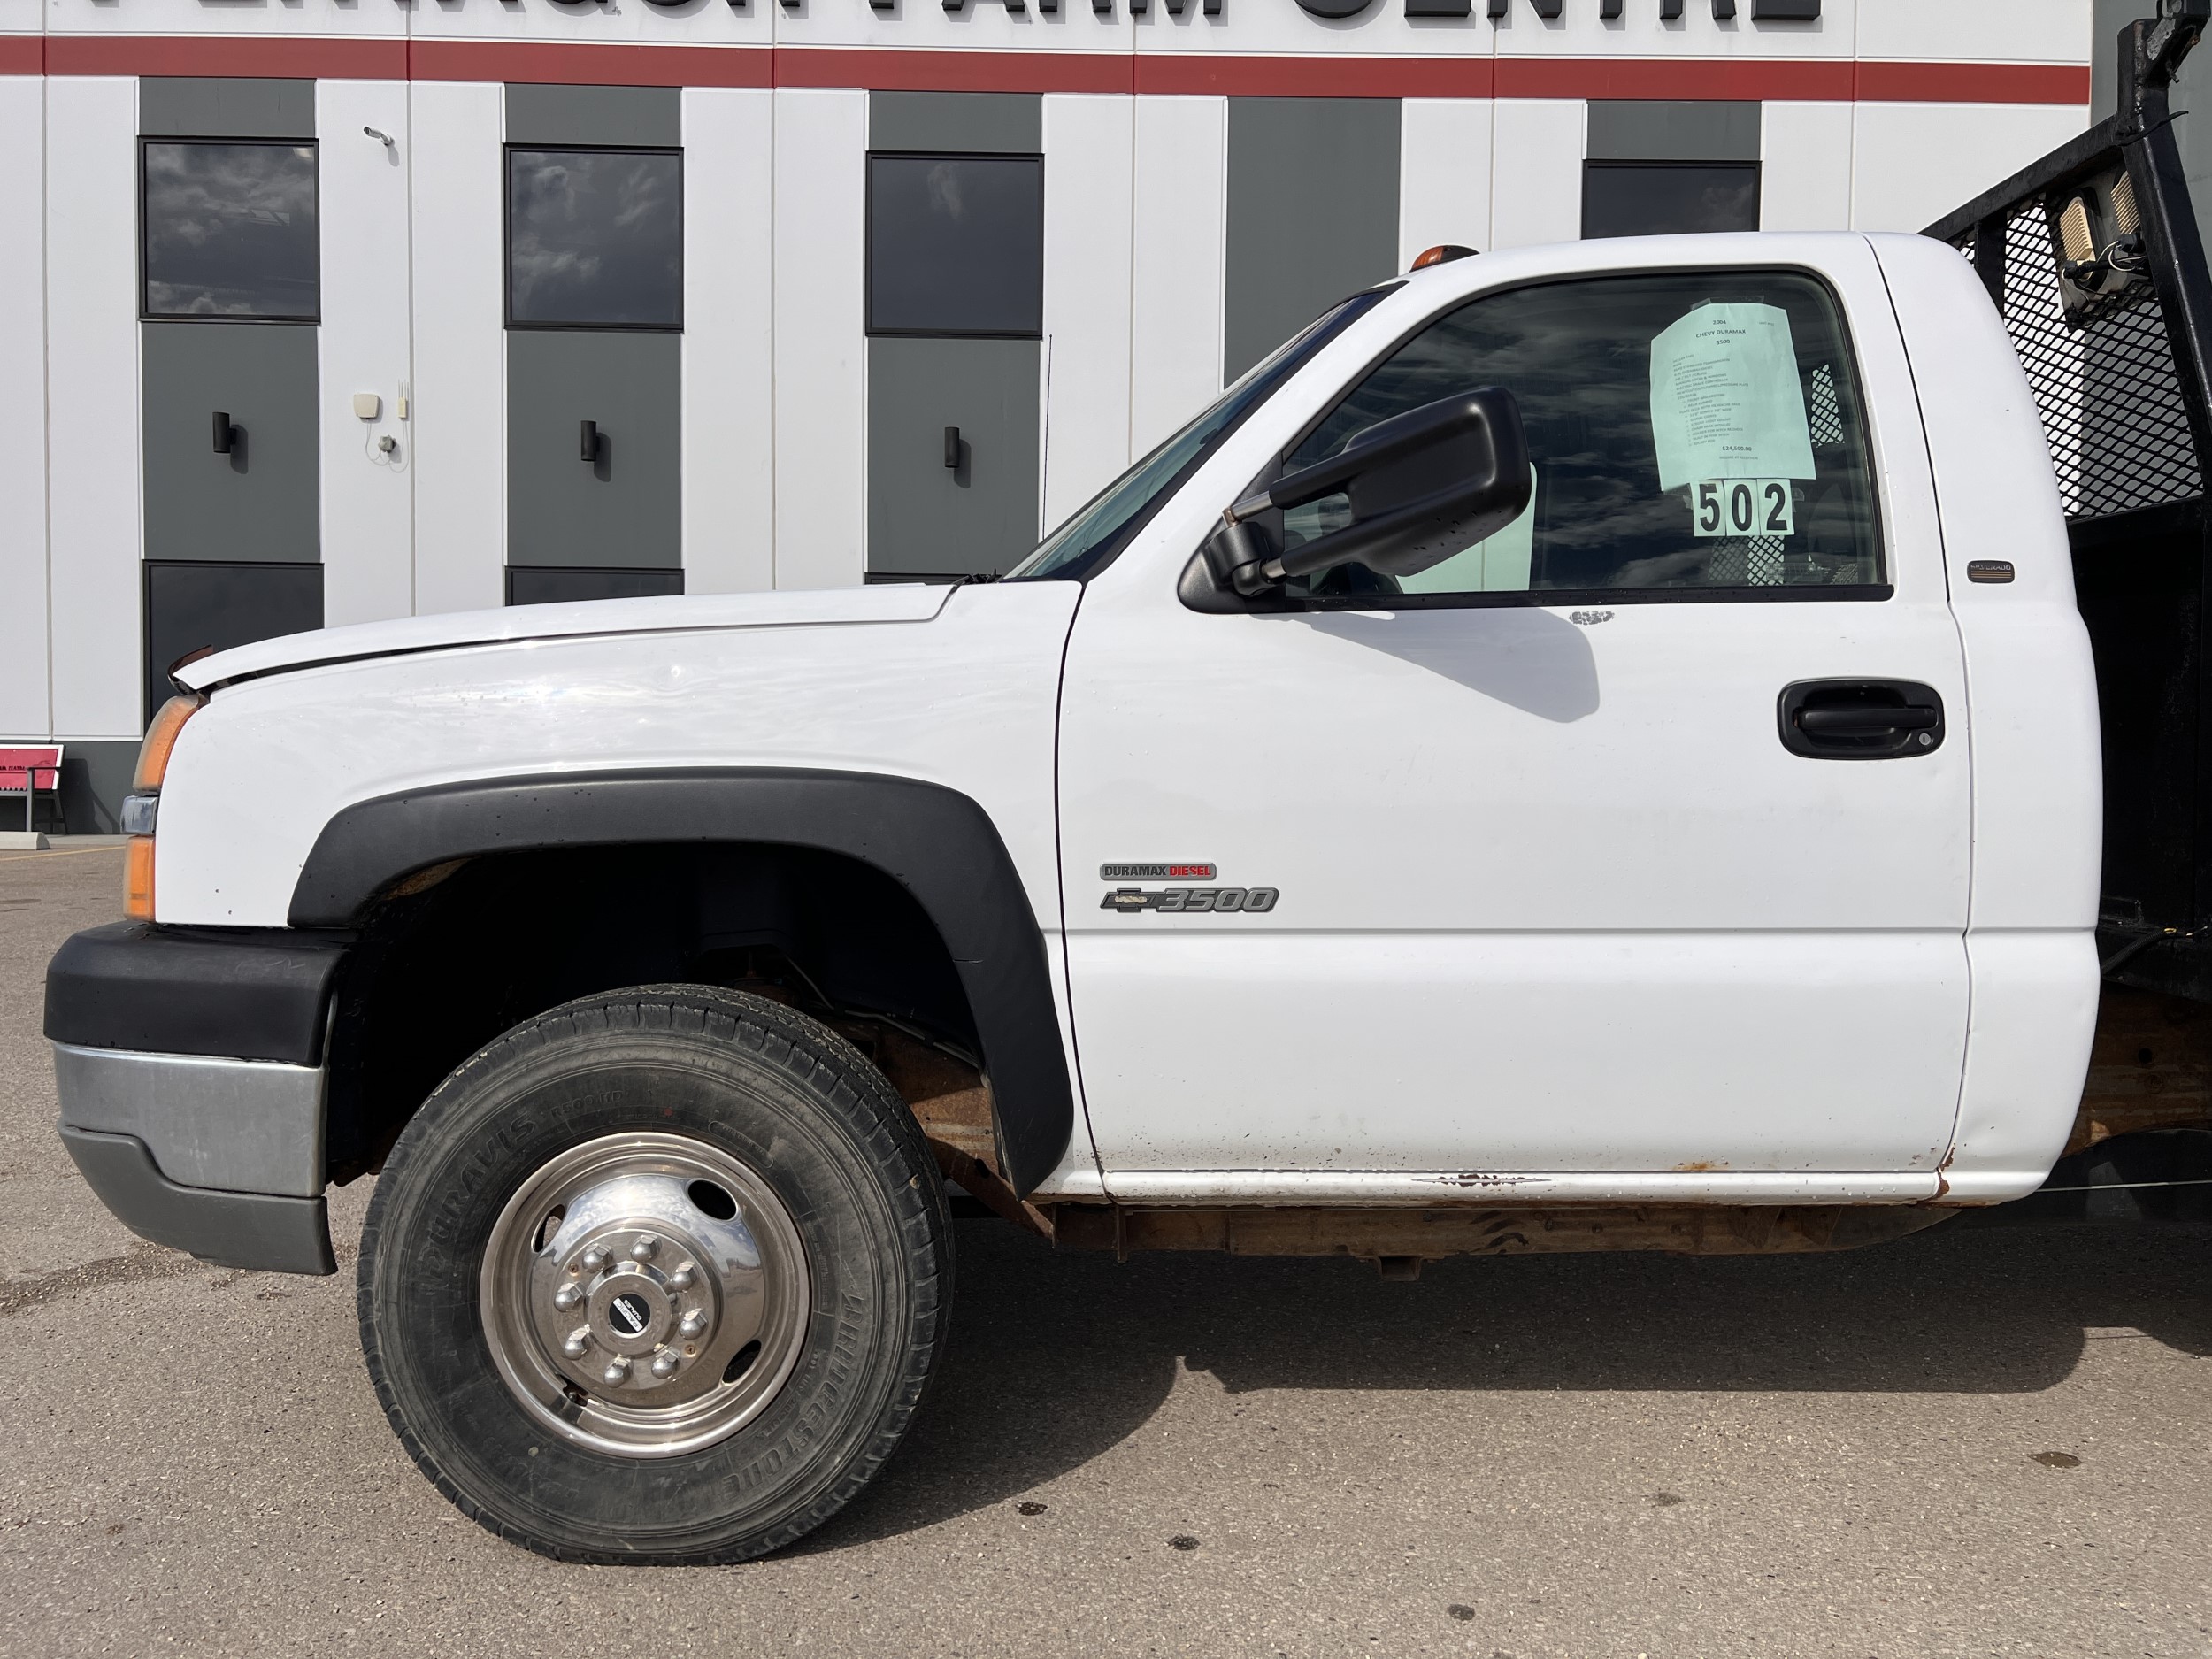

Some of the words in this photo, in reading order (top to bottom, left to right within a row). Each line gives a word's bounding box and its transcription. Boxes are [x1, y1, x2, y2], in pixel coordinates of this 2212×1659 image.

[1700, 483, 1787, 531] 502
[1105, 865, 1166, 876] DURAMAX
[1169, 865, 1211, 876] DIESEL
[1158, 889, 1275, 910] 3500
[617, 1302, 639, 1328] PACIFIC
[722, 1289, 864, 1495] BRIDGESTONE
